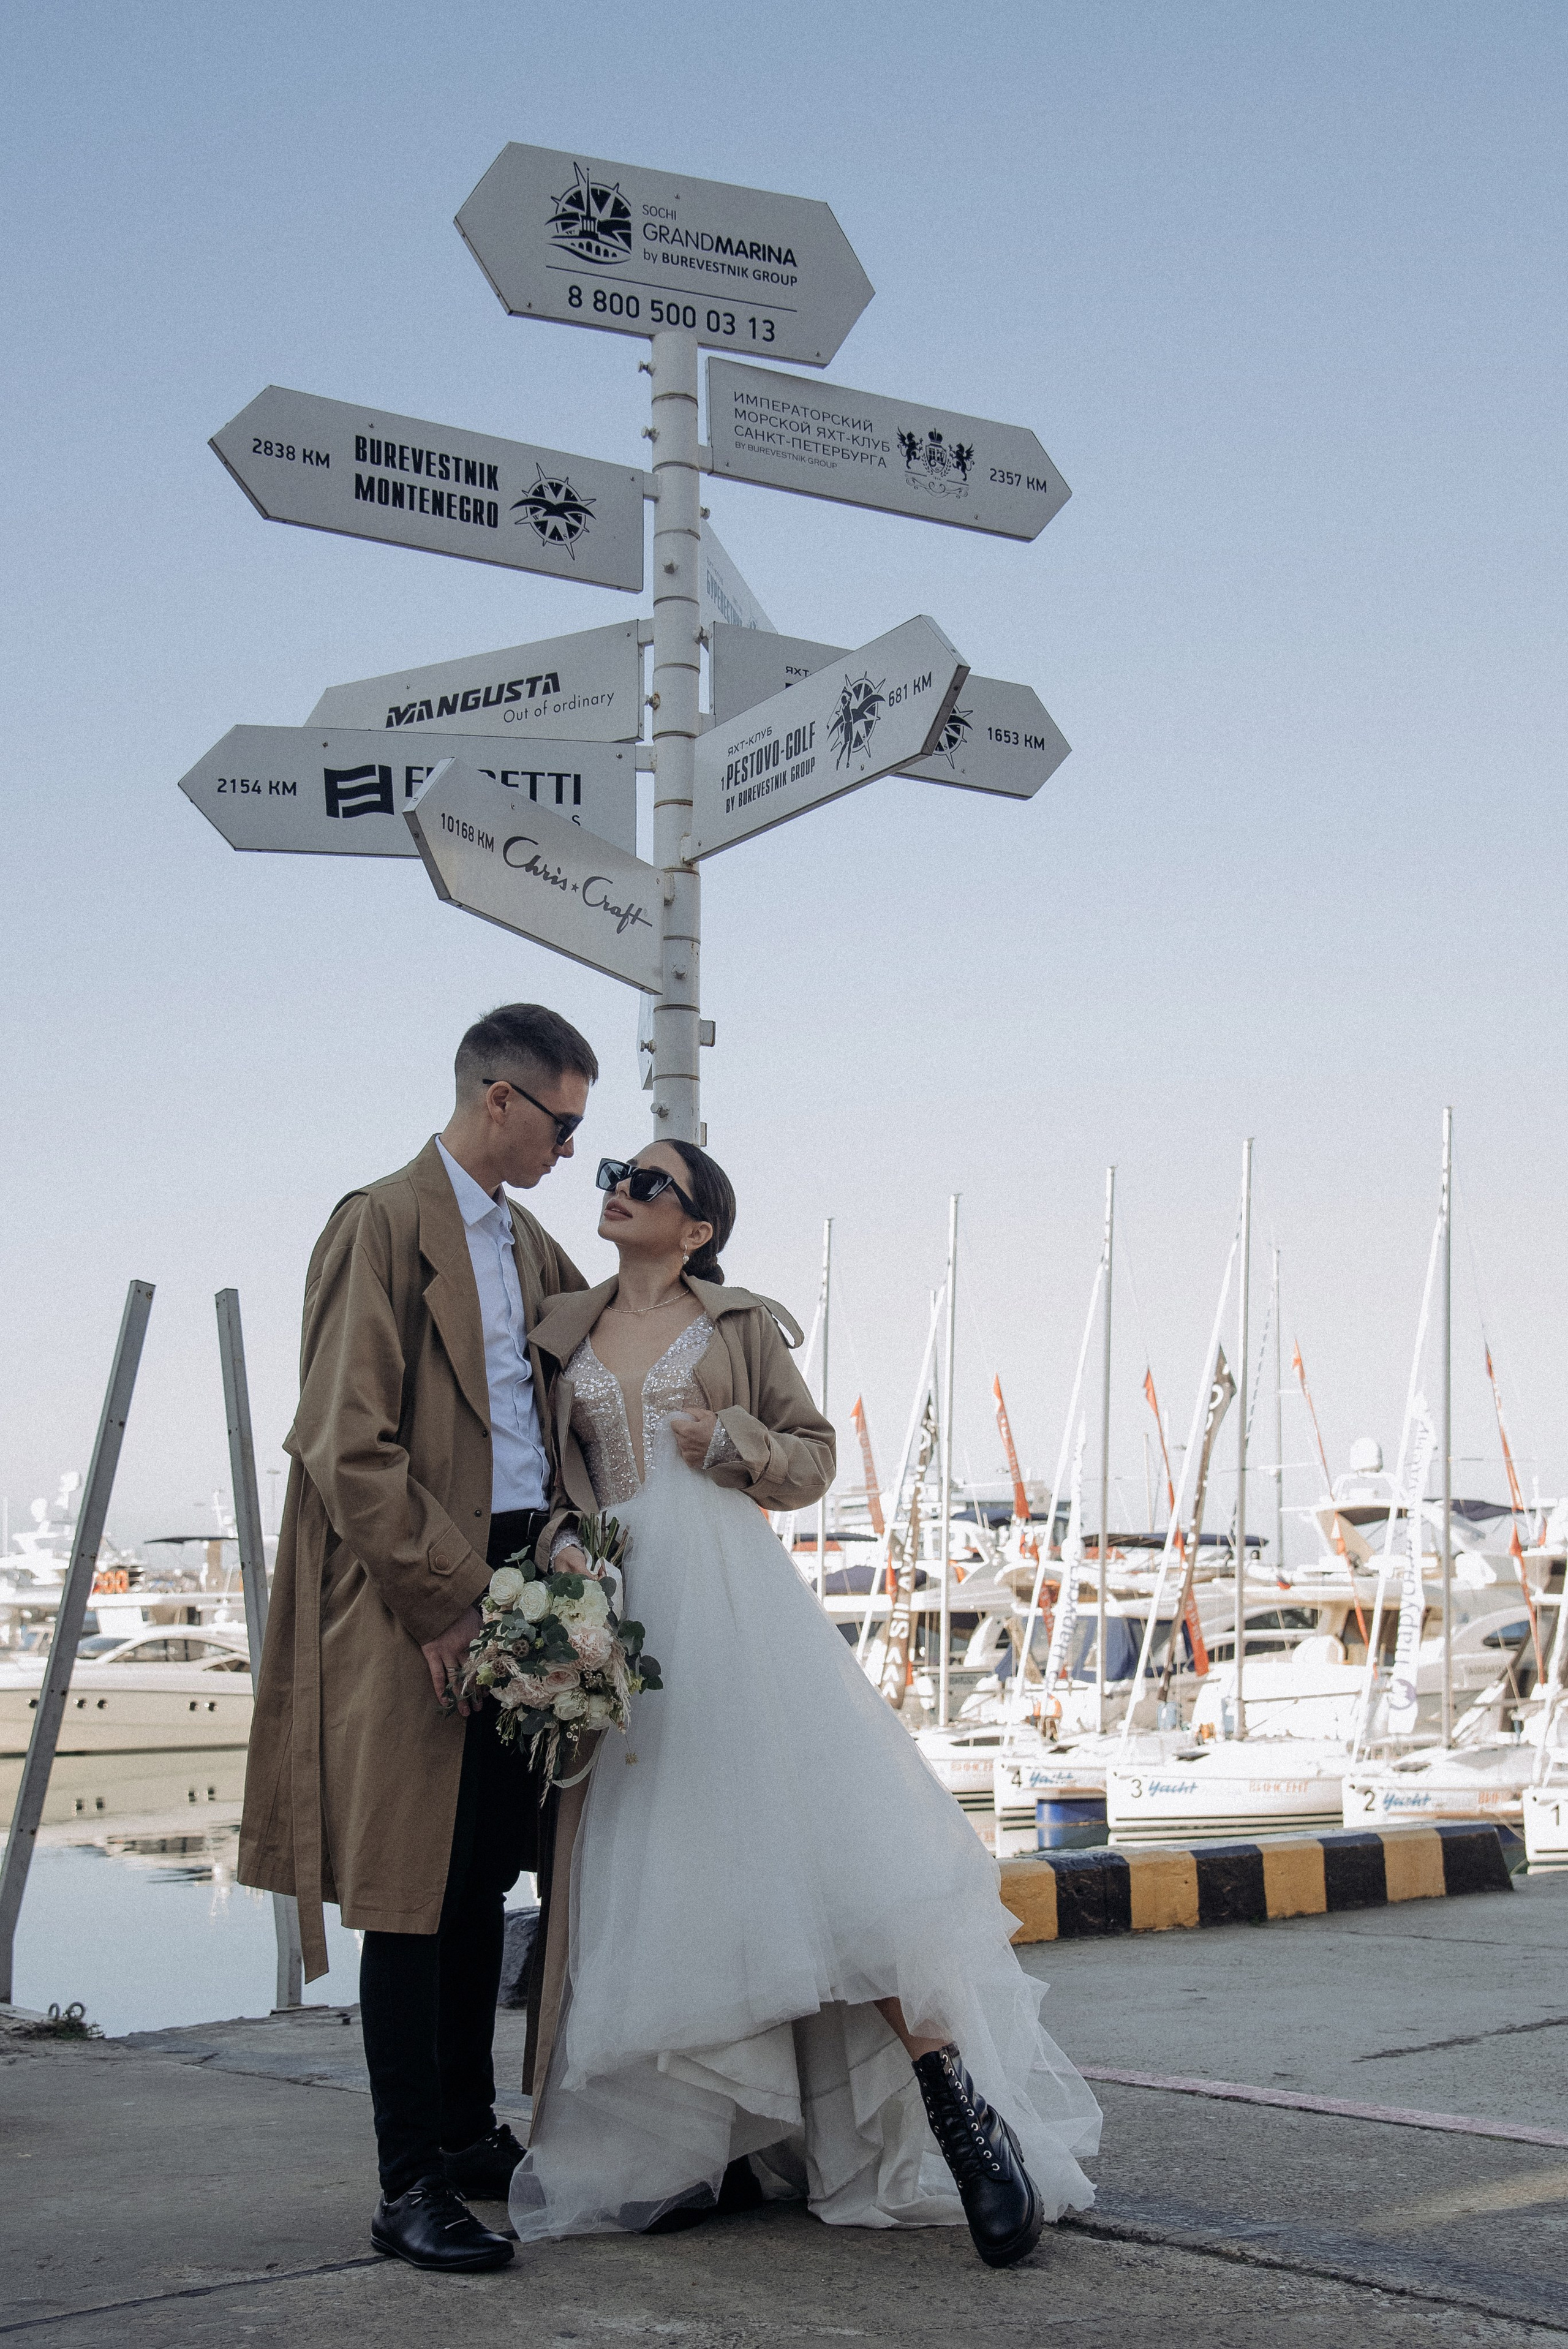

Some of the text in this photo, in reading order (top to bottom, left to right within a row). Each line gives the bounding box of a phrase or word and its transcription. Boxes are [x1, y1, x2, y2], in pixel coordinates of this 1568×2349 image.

[642, 204, 677, 221] SOCHI
[643, 222, 797, 268] GRANDMARINA
[643, 247, 797, 287] by BUREVESTNIK GROUP
[568, 285, 775, 342] 8 800 500 03 13
[734, 392, 873, 433] ИМПЕРАТОРСКИЙ
[734, 408, 891, 453] МОРСКОЙ ЯХТ-КЛУБ
[252, 437, 296, 461] 2838
[734, 425, 887, 469] САНКТ-ПЕТЕРБУРГА
[735, 442, 838, 469] BY BUREVESTNIK GROUP
[355, 434, 499, 492] BUREVESTNIK
[989, 468, 1022, 487] 2357
[354, 473, 499, 529] MONTENEGRO
[385, 671, 561, 729] MANGUSTA
[503, 691, 615, 724] Out of ordinary
[888, 683, 908, 707] 681
[728, 726, 773, 757] ЯХТ-КЛУБ
[987, 726, 1019, 745] 1653
[217, 778, 263, 795] 2154
[726, 756, 815, 814] BY BUREVESTNIK GROUP
[440, 812, 475, 843] 10168
[503, 835, 653, 935] Chris Craft
[1011, 1770, 1022, 1788] 4
[1131, 1779, 1142, 1798] 3
[1363, 1790, 1376, 1811] 2
[1551, 1804, 1559, 1826] 1
